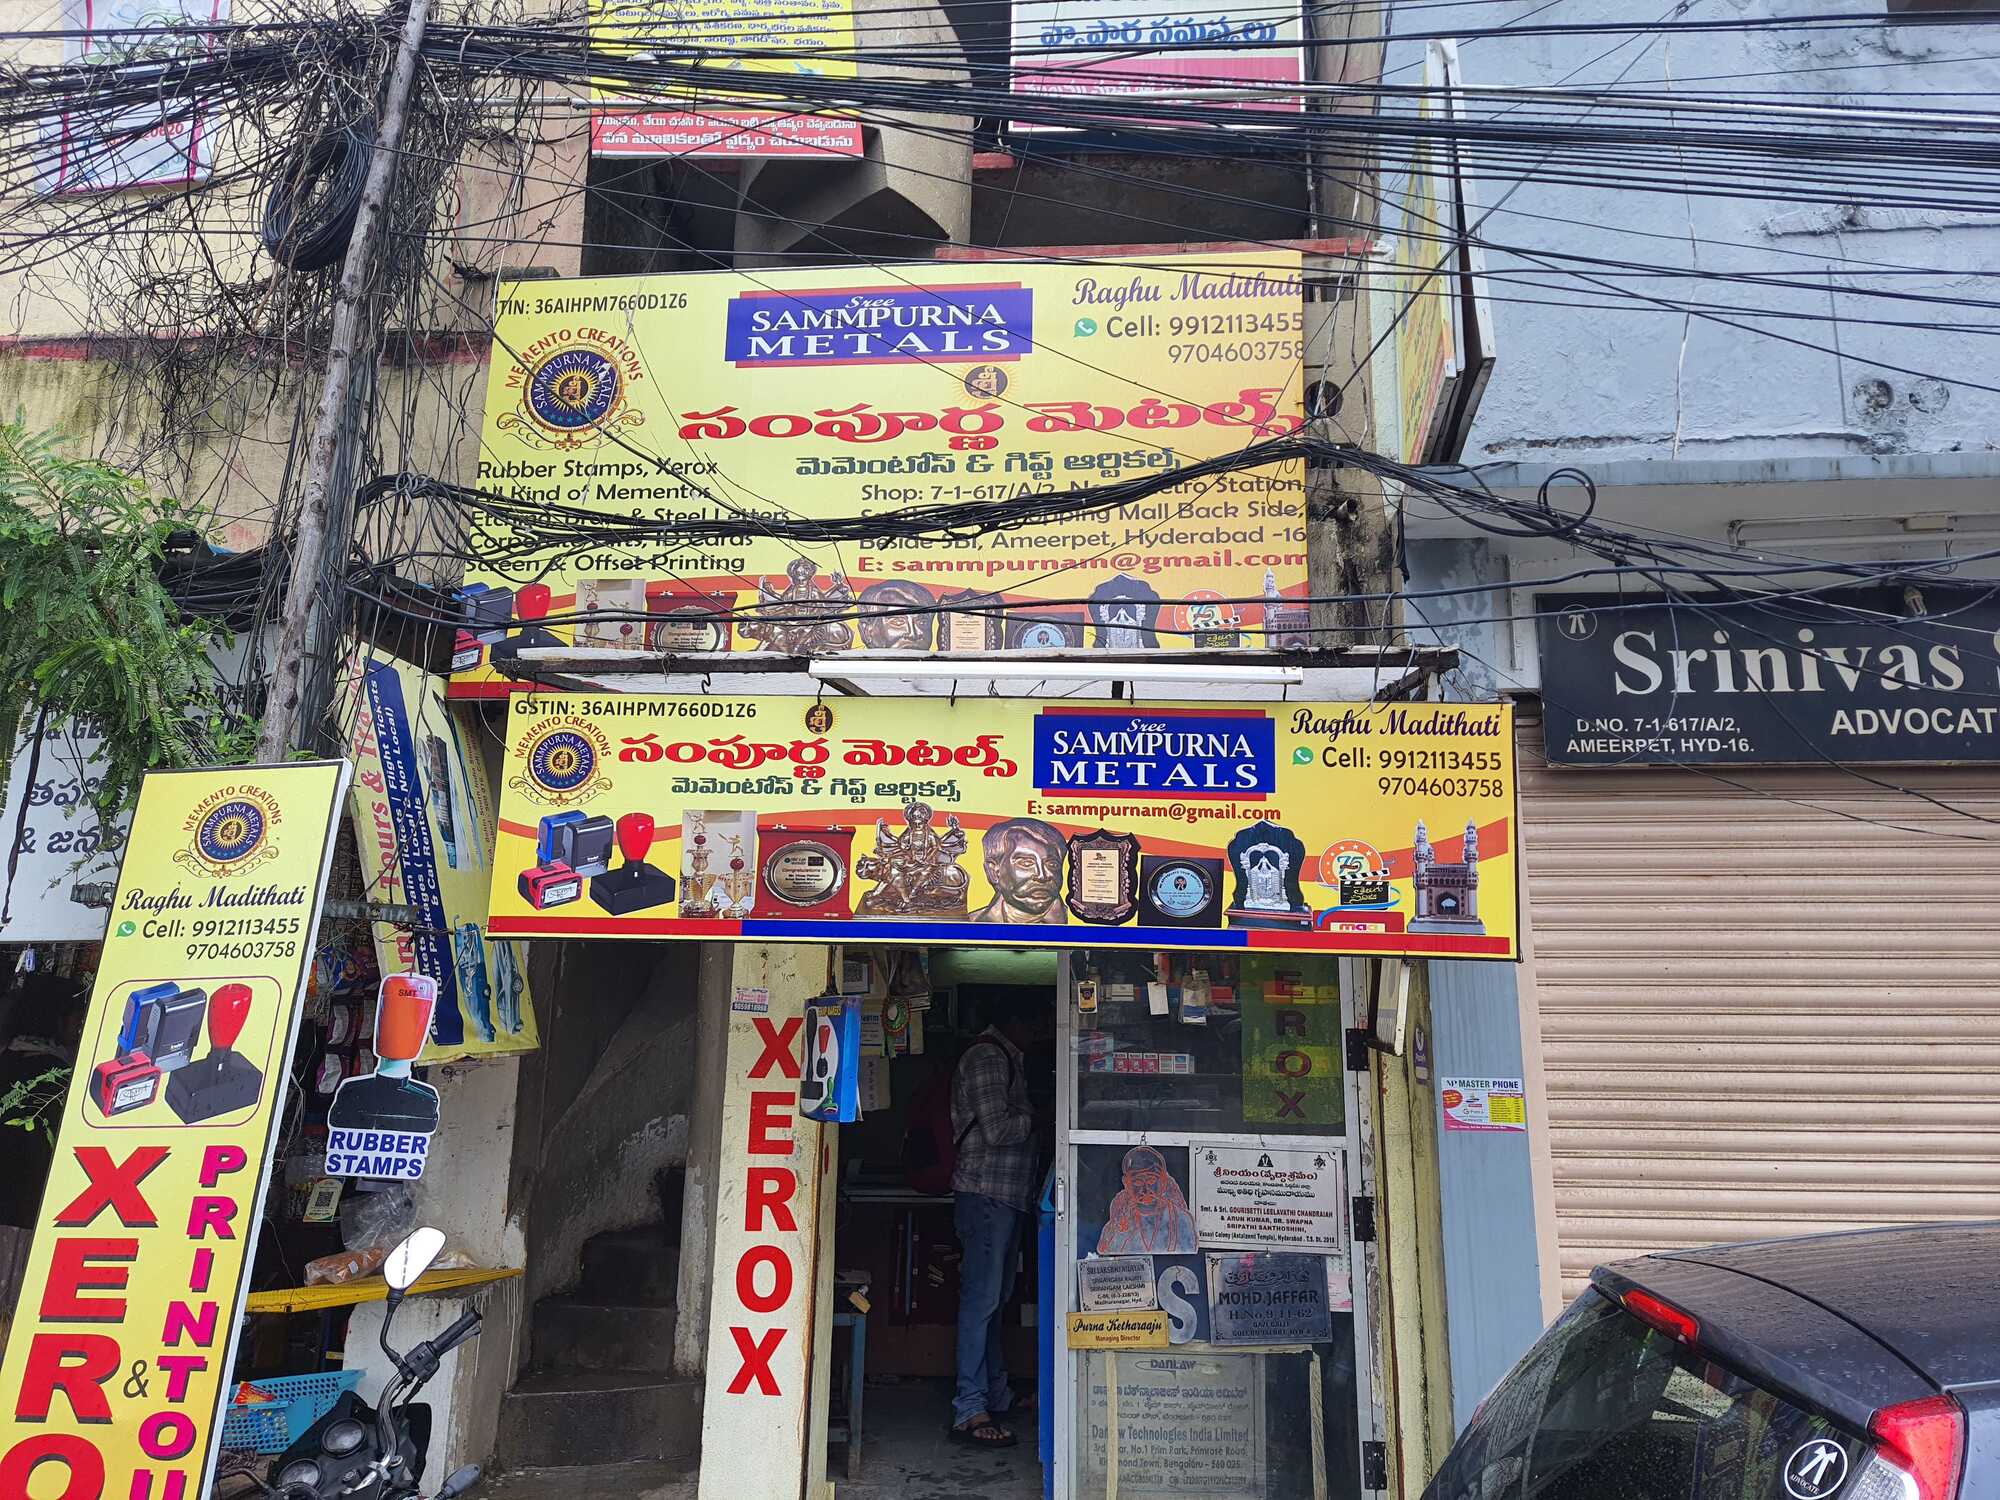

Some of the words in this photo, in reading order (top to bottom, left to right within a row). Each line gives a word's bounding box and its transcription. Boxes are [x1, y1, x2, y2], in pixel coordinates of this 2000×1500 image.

[496, 299, 530, 315] TIN:
[535, 293, 687, 314] 36AIHPM7660D1Z6
[845, 296, 895, 309] Sree
[1072, 278, 1162, 312] Raghu
[751, 304, 1006, 332] SAMMPURNA
[1106, 317, 1161, 339] Cell:
[1169, 313, 1303, 336] 9912113455
[747, 329, 1010, 358] METALS
[1168, 341, 1304, 365] 9704603758
[505, 327, 572, 389] MEMENTO
[577, 327, 644, 383] CREATIONS
[678, 402, 1004, 451] సంపూర్ణ
[476, 460, 556, 479] Rubber
[563, 460, 648, 484] Stamps,
[655, 458, 718, 476] Xerox
[966, 454, 994, 474] &
[510, 484, 561, 502] Kind
[567, 484, 590, 501] of
[596, 484, 711, 500] Mementos
[862, 485, 923, 502] Shop:
[1216, 476, 1307, 494] Station,
[654, 508, 706, 523] Steel
[1119, 502, 1169, 520] Mall
[1178, 502, 1239, 519] Back
[1248, 501, 1305, 519] Side,
[992, 531, 1117, 551] Ameerpet,
[1125, 526, 1264, 547] Hyderabad
[1272, 527, 1307, 542] -16
[575, 554, 643, 571] Offset
[650, 553, 745, 573] Printing
[858, 557, 883, 572] E:
[892, 548, 1308, 578] sammpurnam@gmail.com
[1612, 628, 1965, 696] Srinivas
[370, 679, 387, 737] Tickets
[514, 700, 575, 716] GSTIN:
[581, 700, 757, 718] 36AIHPM7660D1Z6
[385, 707, 402, 756] Local)
[514, 716, 561, 759] MEMENTO
[564, 715, 612, 757] CREATIONS
[1126, 718, 1167, 732] Sree
[1290, 708, 1372, 742] Raghu
[1379, 708, 1501, 737] Madithati
[1577, 717, 1629, 733] D.NO.
[1634, 717, 1741, 734] 7-1-617/A/2,
[618, 733, 830, 778] సంపూర్ణ
[842, 735, 1018, 778] మెటల్స్
[1053, 730, 1255, 758] SAMMPURNA
[1566, 738, 1676, 755] AMEERPET,
[1681, 738, 1755, 753] HYD-16.
[382, 743, 398, 790] Flight
[1322, 747, 1371, 768] Cell:
[1379, 750, 1502, 771] 9912113455
[360, 768, 386, 795] &
[397, 758, 409, 793] Non
[1050, 760, 1259, 789] METALS
[1378, 776, 1503, 798] 9704603758
[182, 785, 235, 832] MEMENTO
[239, 784, 283, 825] CREATIONS
[1027, 800, 1042, 815] E:
[1046, 801, 1281, 824] sammpurnam@gmail.com
[201, 805, 246, 847] SAMMPURNA
[247, 808, 261, 846] METALS
[413, 795, 432, 859] Rentals
[371, 800, 401, 889] Tours
[424, 864, 436, 891] Car
[121, 888, 192, 916] Raghu
[198, 883, 308, 908] Madithati
[142, 919, 185, 938] Cell:
[191, 918, 300, 937] 9912113455
[186, 941, 296, 960] 9704603758
[398, 988, 418, 997] SMT
[1458, 1080, 1490, 1088] MASTER
[1492, 1081, 1519, 1089] PHONE
[329, 1130, 427, 1154] RUBBER
[326, 1153, 423, 1177] STAMPS
[726, 1016, 804, 1397] XEROX
[1158, 1265, 1200, 1344] S
[1073, 1318, 1105, 1332] Purna
[123, 1359, 148, 1399] &
[1128, 1425, 1187, 1443] Technologies
[1189, 1426, 1213, 1441] India
[1215, 1426, 1249, 1442] Limited
[1790, 1474, 1820, 1495] ADVOCATE
